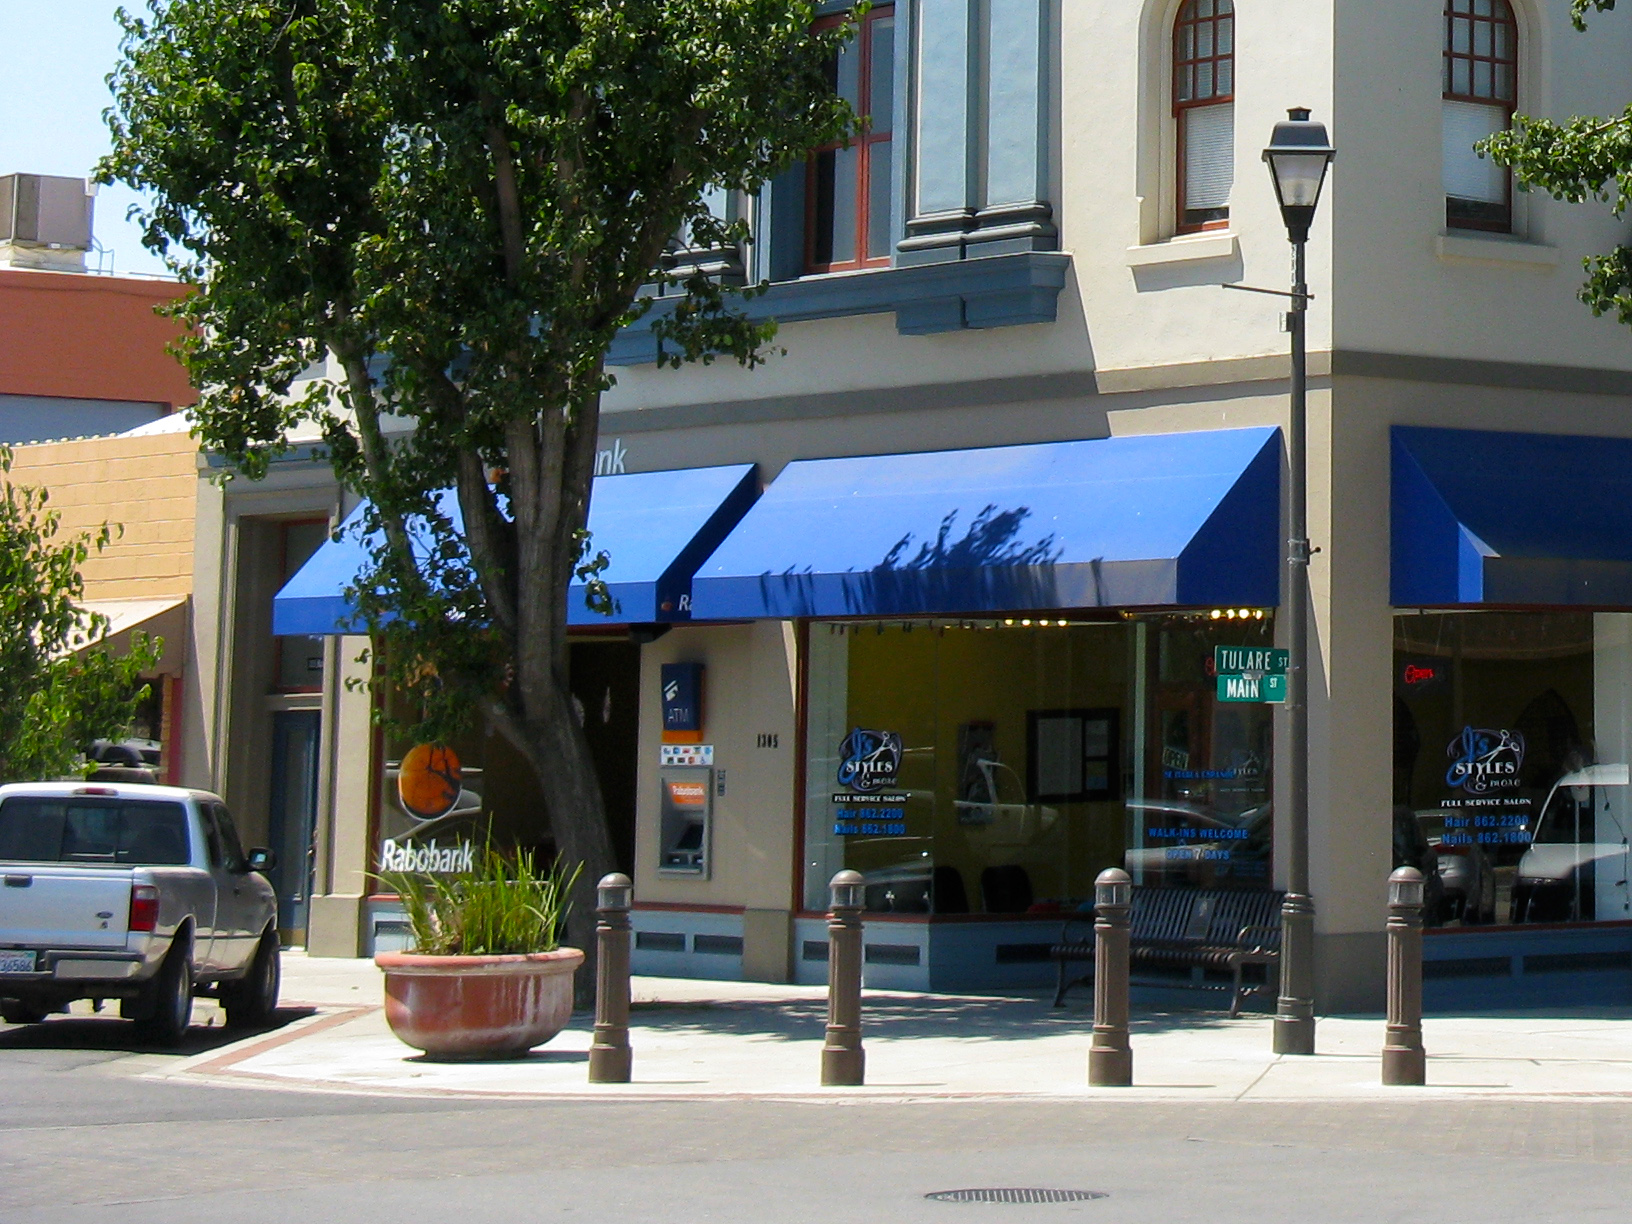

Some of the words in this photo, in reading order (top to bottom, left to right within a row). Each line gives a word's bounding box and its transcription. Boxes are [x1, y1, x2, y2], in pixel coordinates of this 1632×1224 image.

[1221, 650, 1272, 670] TULARE
[1278, 657, 1288, 667] ST
[1226, 678, 1259, 698] MAIN
[1269, 677, 1278, 688] ST
[668, 707, 690, 723] ATM
[757, 733, 778, 749] 1305
[846, 761, 893, 775] STYLES
[1455, 762, 1515, 776] STYLES
[1441, 799, 1462, 807] FULL
[1444, 816, 1470, 827] Hair
[1474, 815, 1530, 827] 862.2200
[1148, 828, 1197, 838] WALK-INS
[1199, 828, 1249, 840] WELCOME
[1442, 833, 1473, 845] Nails
[380, 838, 476, 873] Rabobank
[1165, 849, 1193, 860] OPEN
[1203, 849, 1231, 861] DAYS
